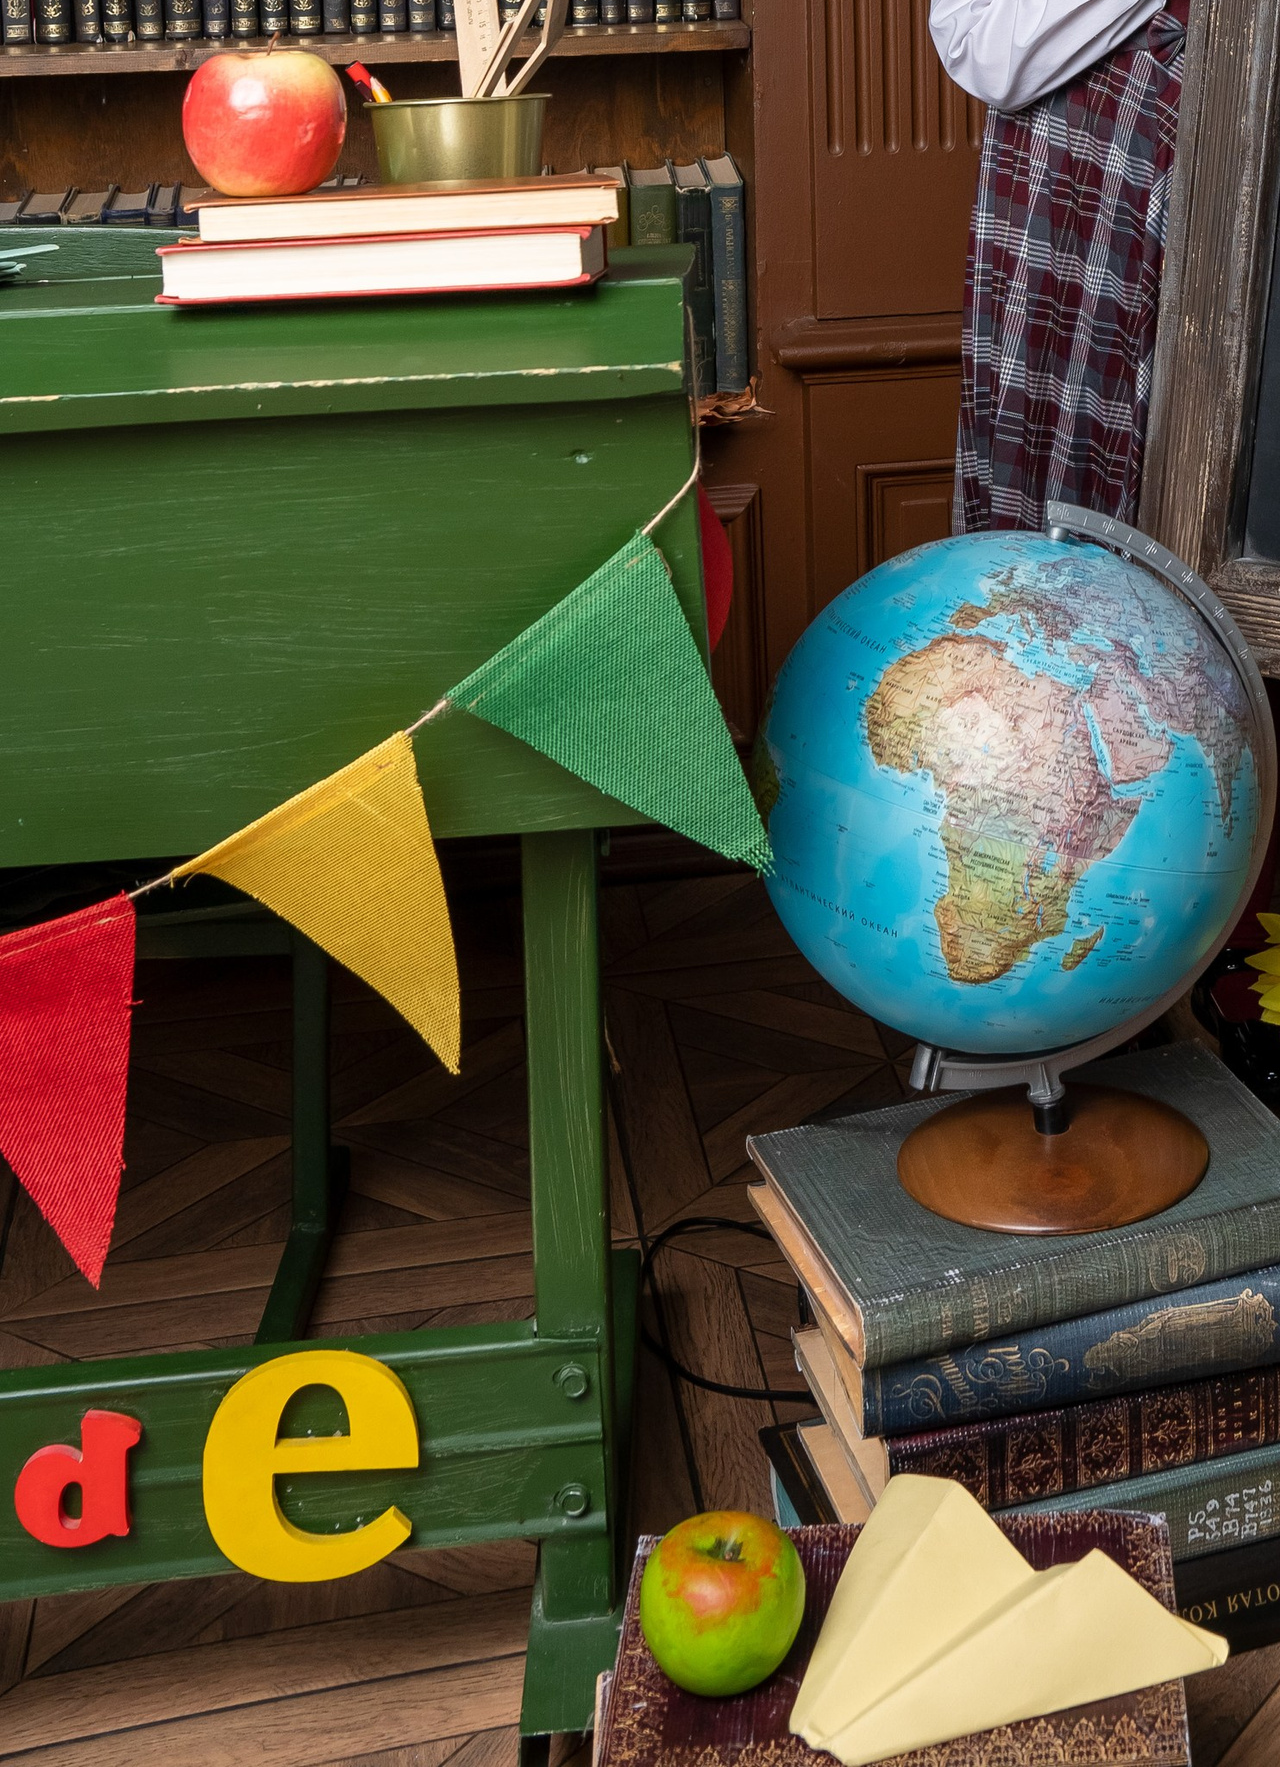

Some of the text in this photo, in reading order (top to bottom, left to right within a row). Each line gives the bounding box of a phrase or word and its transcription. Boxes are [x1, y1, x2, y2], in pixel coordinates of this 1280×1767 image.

[860, 635, 887, 654] ОКЕАН
[860, 915, 899, 938] ОКЕАН
[14, 1350, 419, 1582] d e
[1188, 1510, 1206, 1544] PS
